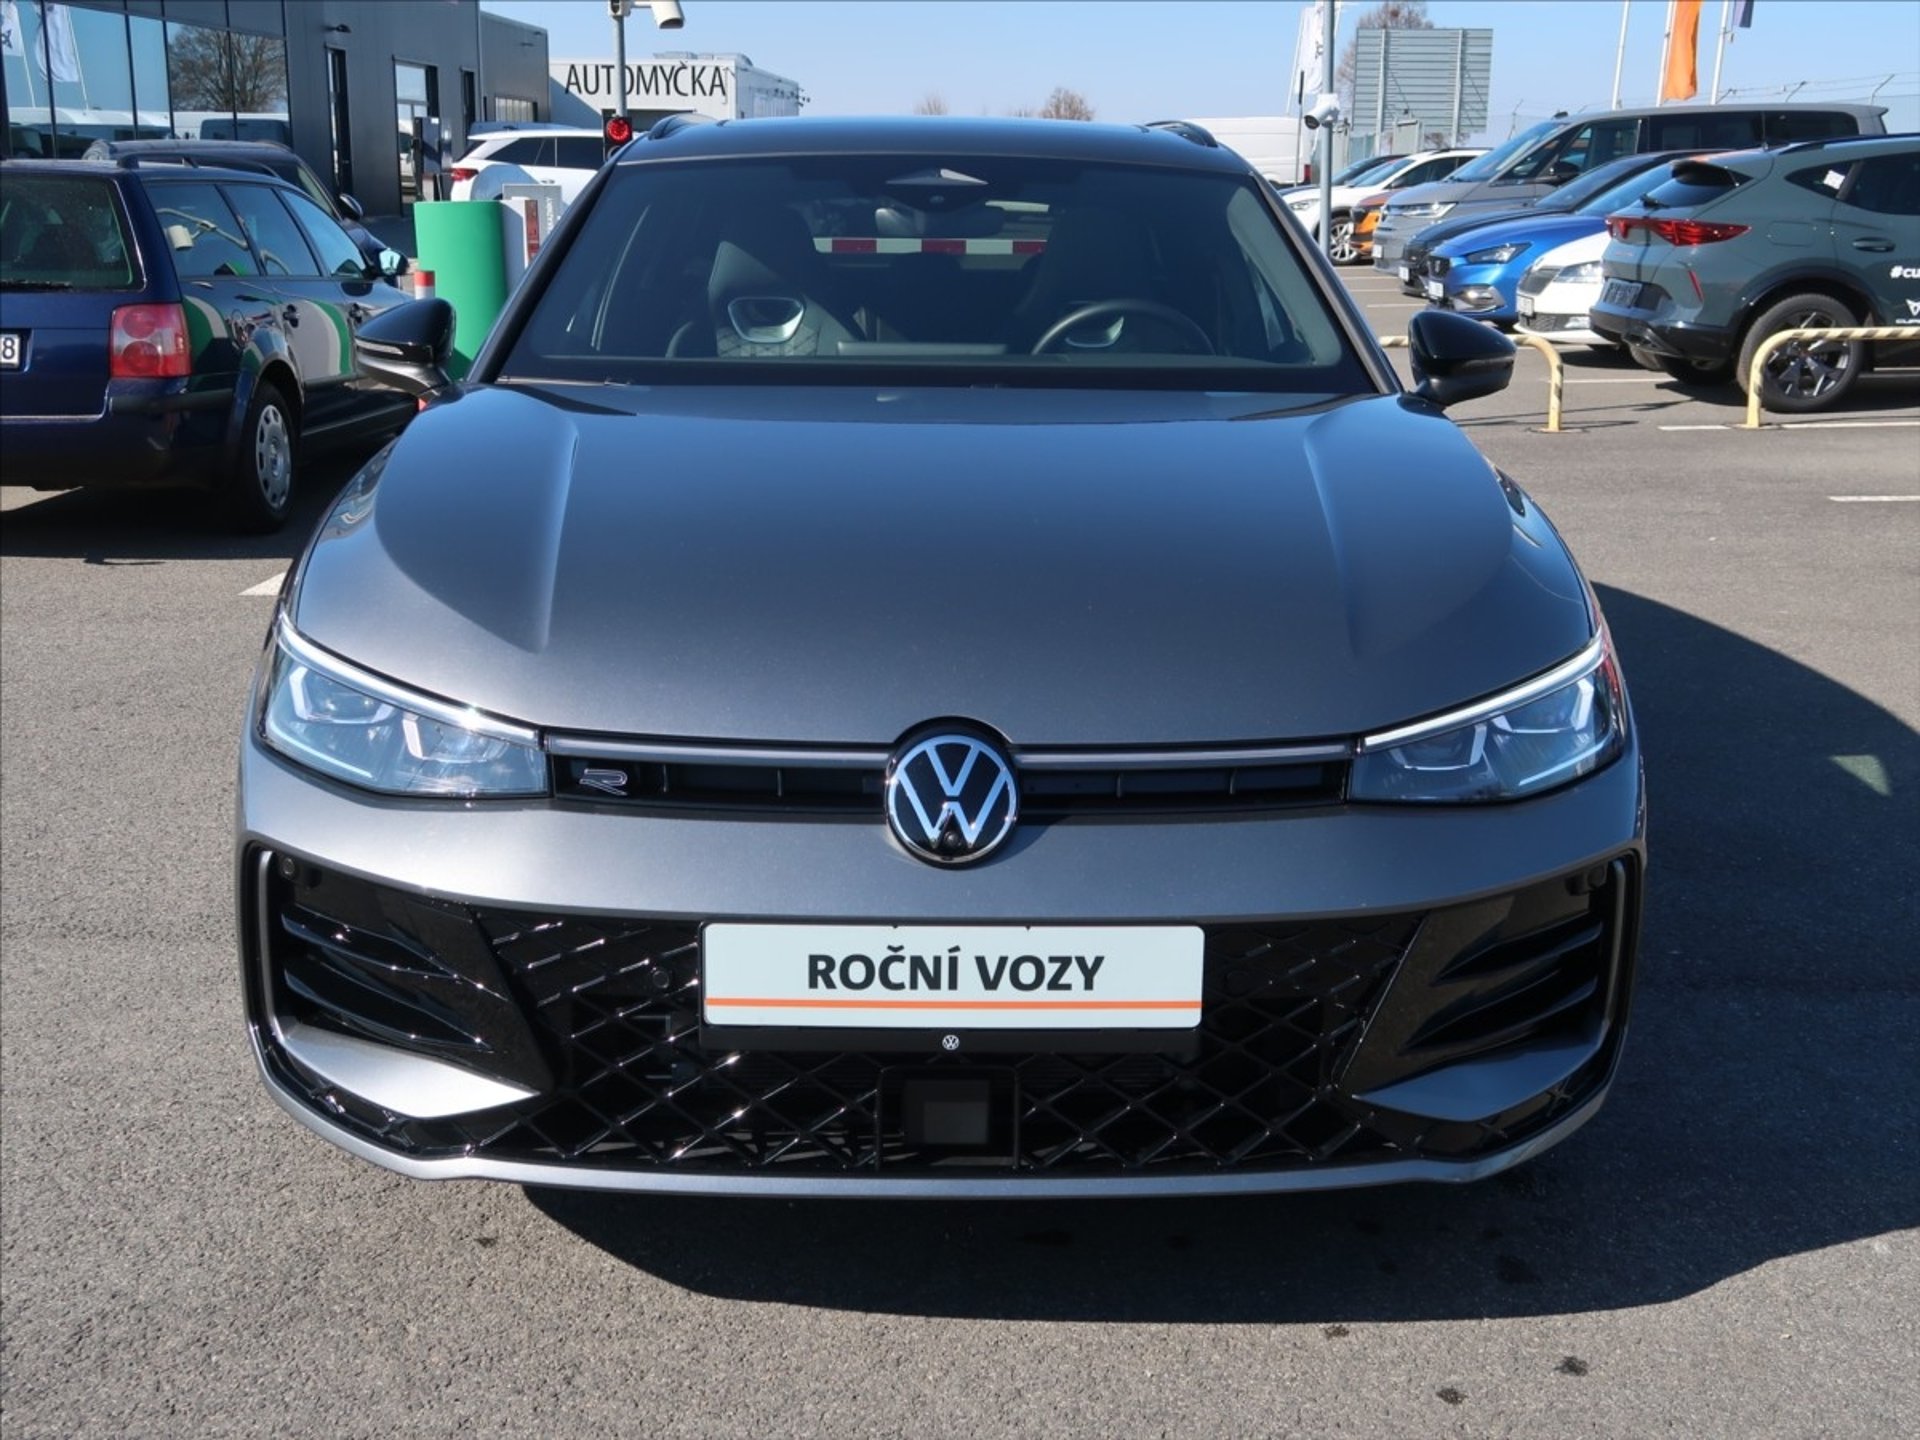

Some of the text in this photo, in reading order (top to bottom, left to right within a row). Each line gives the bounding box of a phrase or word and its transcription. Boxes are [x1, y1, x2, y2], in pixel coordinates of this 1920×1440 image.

[2, 336, 15, 360] 8
[808, 944, 1105, 992] ROČNÍ VOZY
